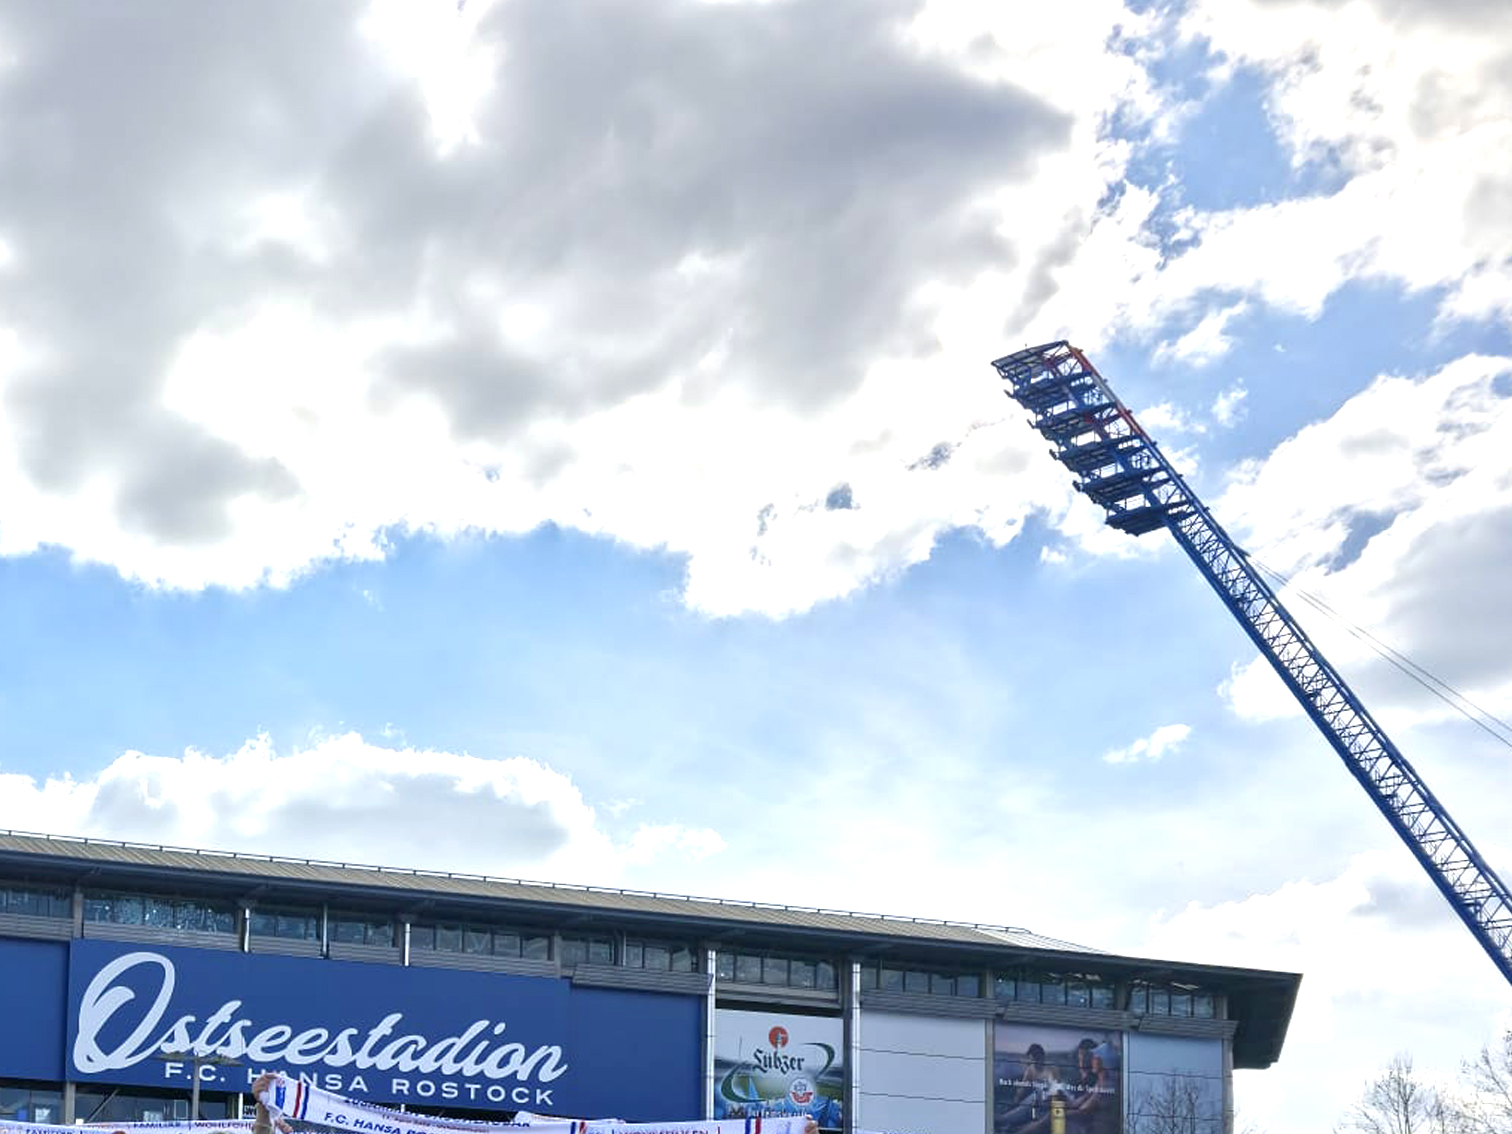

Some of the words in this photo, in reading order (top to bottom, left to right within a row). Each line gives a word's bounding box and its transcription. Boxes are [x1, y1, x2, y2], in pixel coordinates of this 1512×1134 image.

[73, 951, 568, 1083] Ostseestadion
[165, 1063, 225, 1082] F.C.
[392, 1079, 554, 1105] ROSTOCK
[324, 1112, 349, 1126] F.C.
